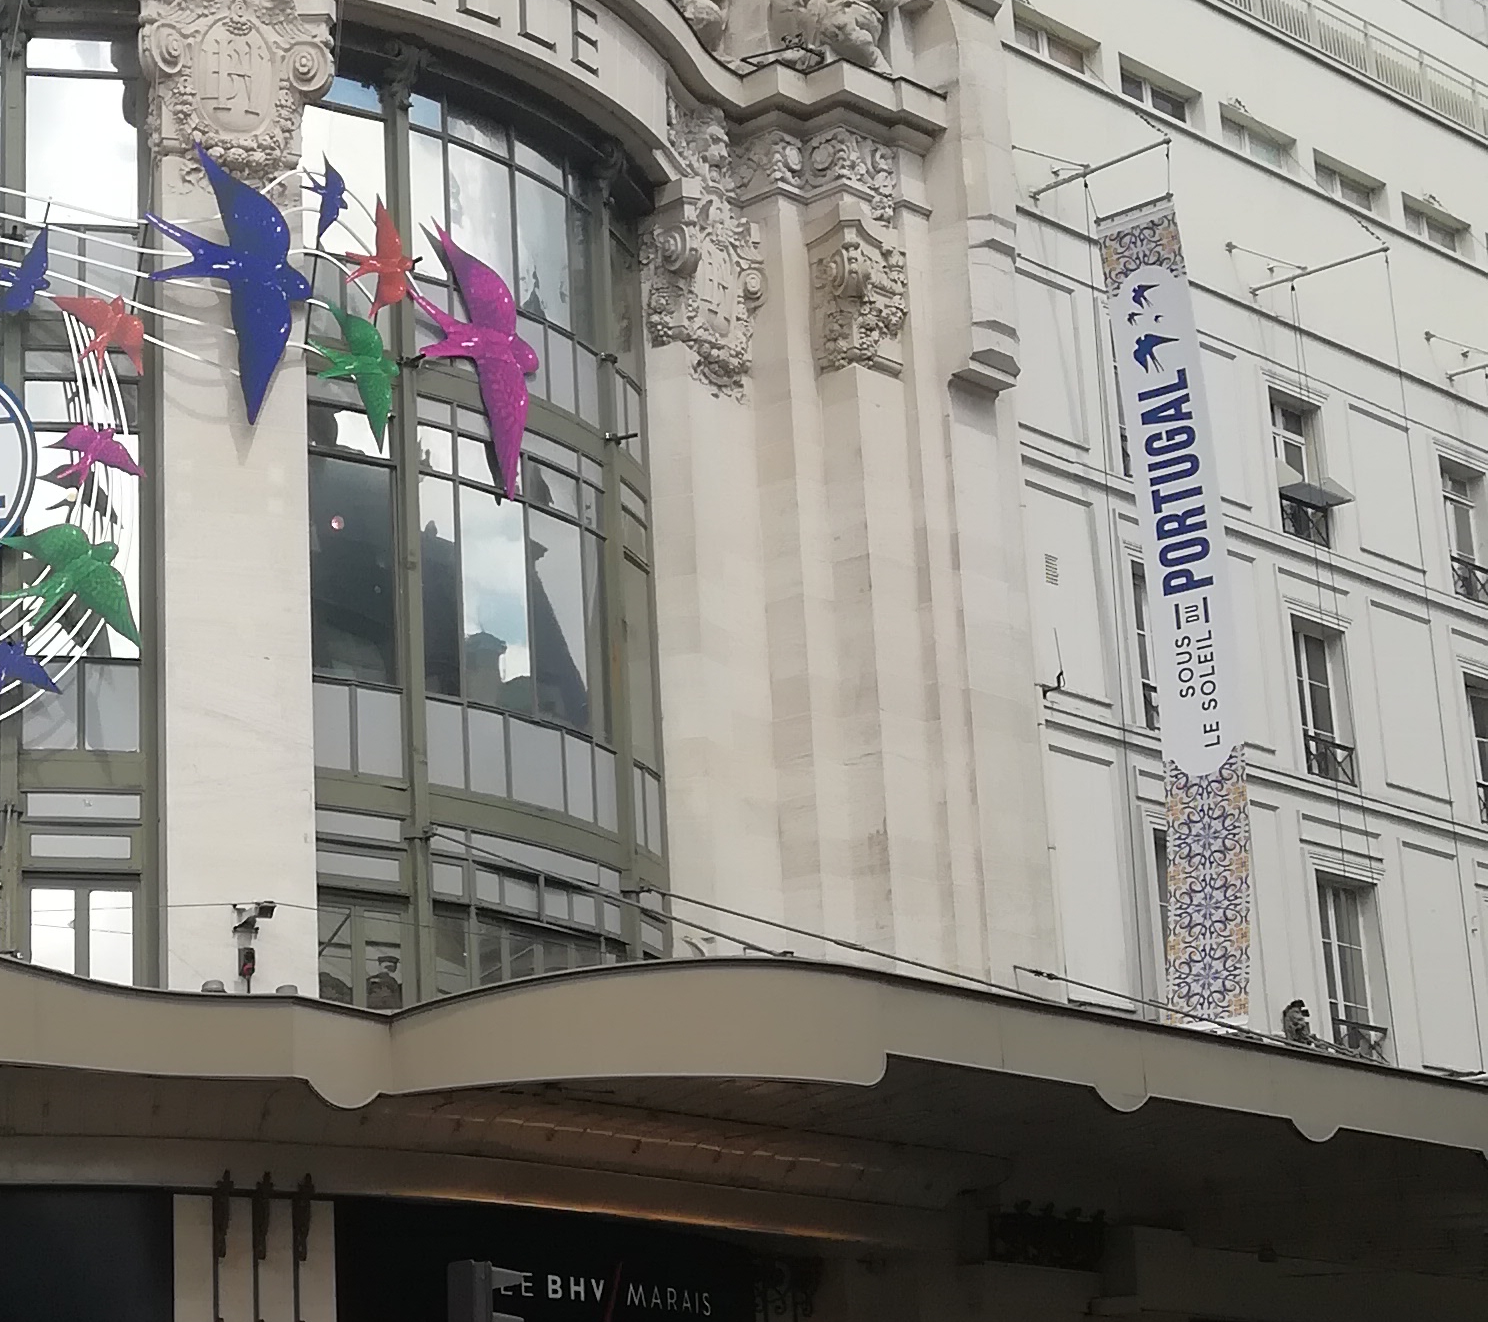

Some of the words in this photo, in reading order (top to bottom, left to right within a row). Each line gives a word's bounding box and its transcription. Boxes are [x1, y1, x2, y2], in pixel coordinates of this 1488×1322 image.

[1137, 368, 1214, 598] PORTUGAL
[1185, 604, 1200, 623] DU
[1175, 635, 1195, 699] SOUS
[1195, 629, 1218, 715] SOLEIL
[1203, 721, 1222, 748] LE
